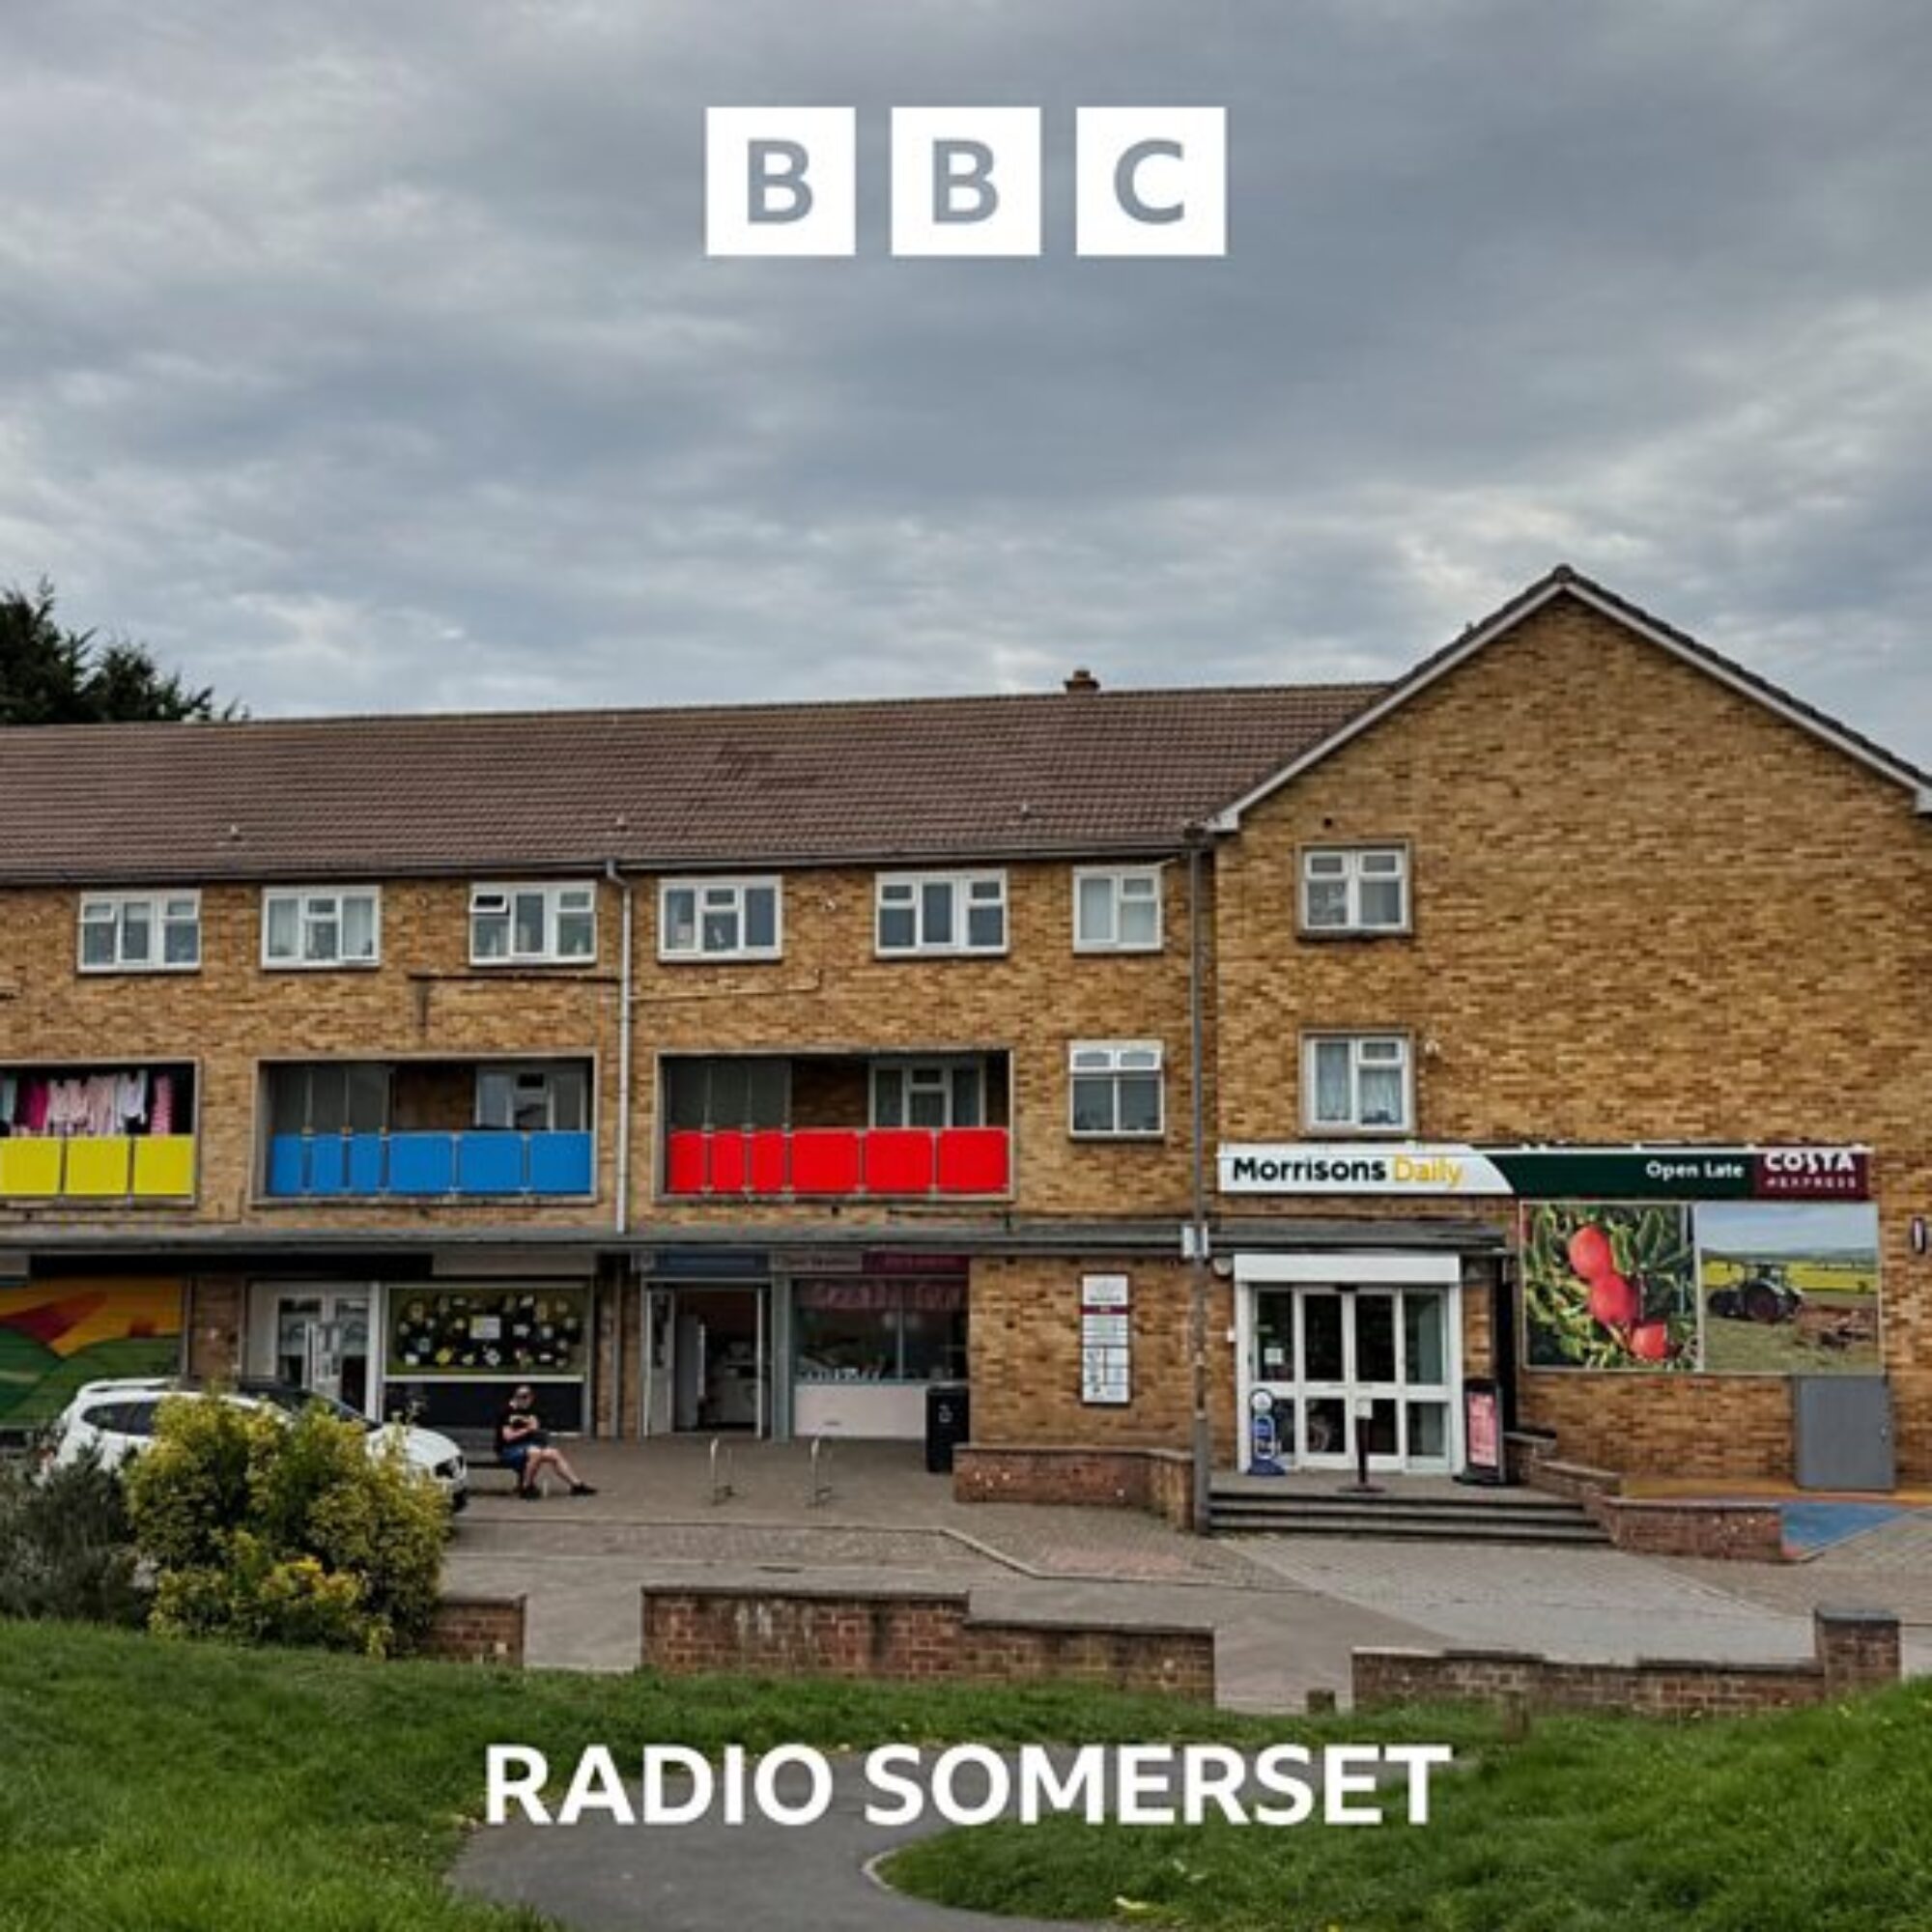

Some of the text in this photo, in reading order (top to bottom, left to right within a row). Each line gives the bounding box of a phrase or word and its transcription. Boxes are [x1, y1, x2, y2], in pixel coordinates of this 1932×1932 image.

[1233, 1154, 1463, 1187] Morrisons Daily
[1645, 1160, 1745, 1180] Open Late
[1765, 1151, 1856, 1175] COSTA
